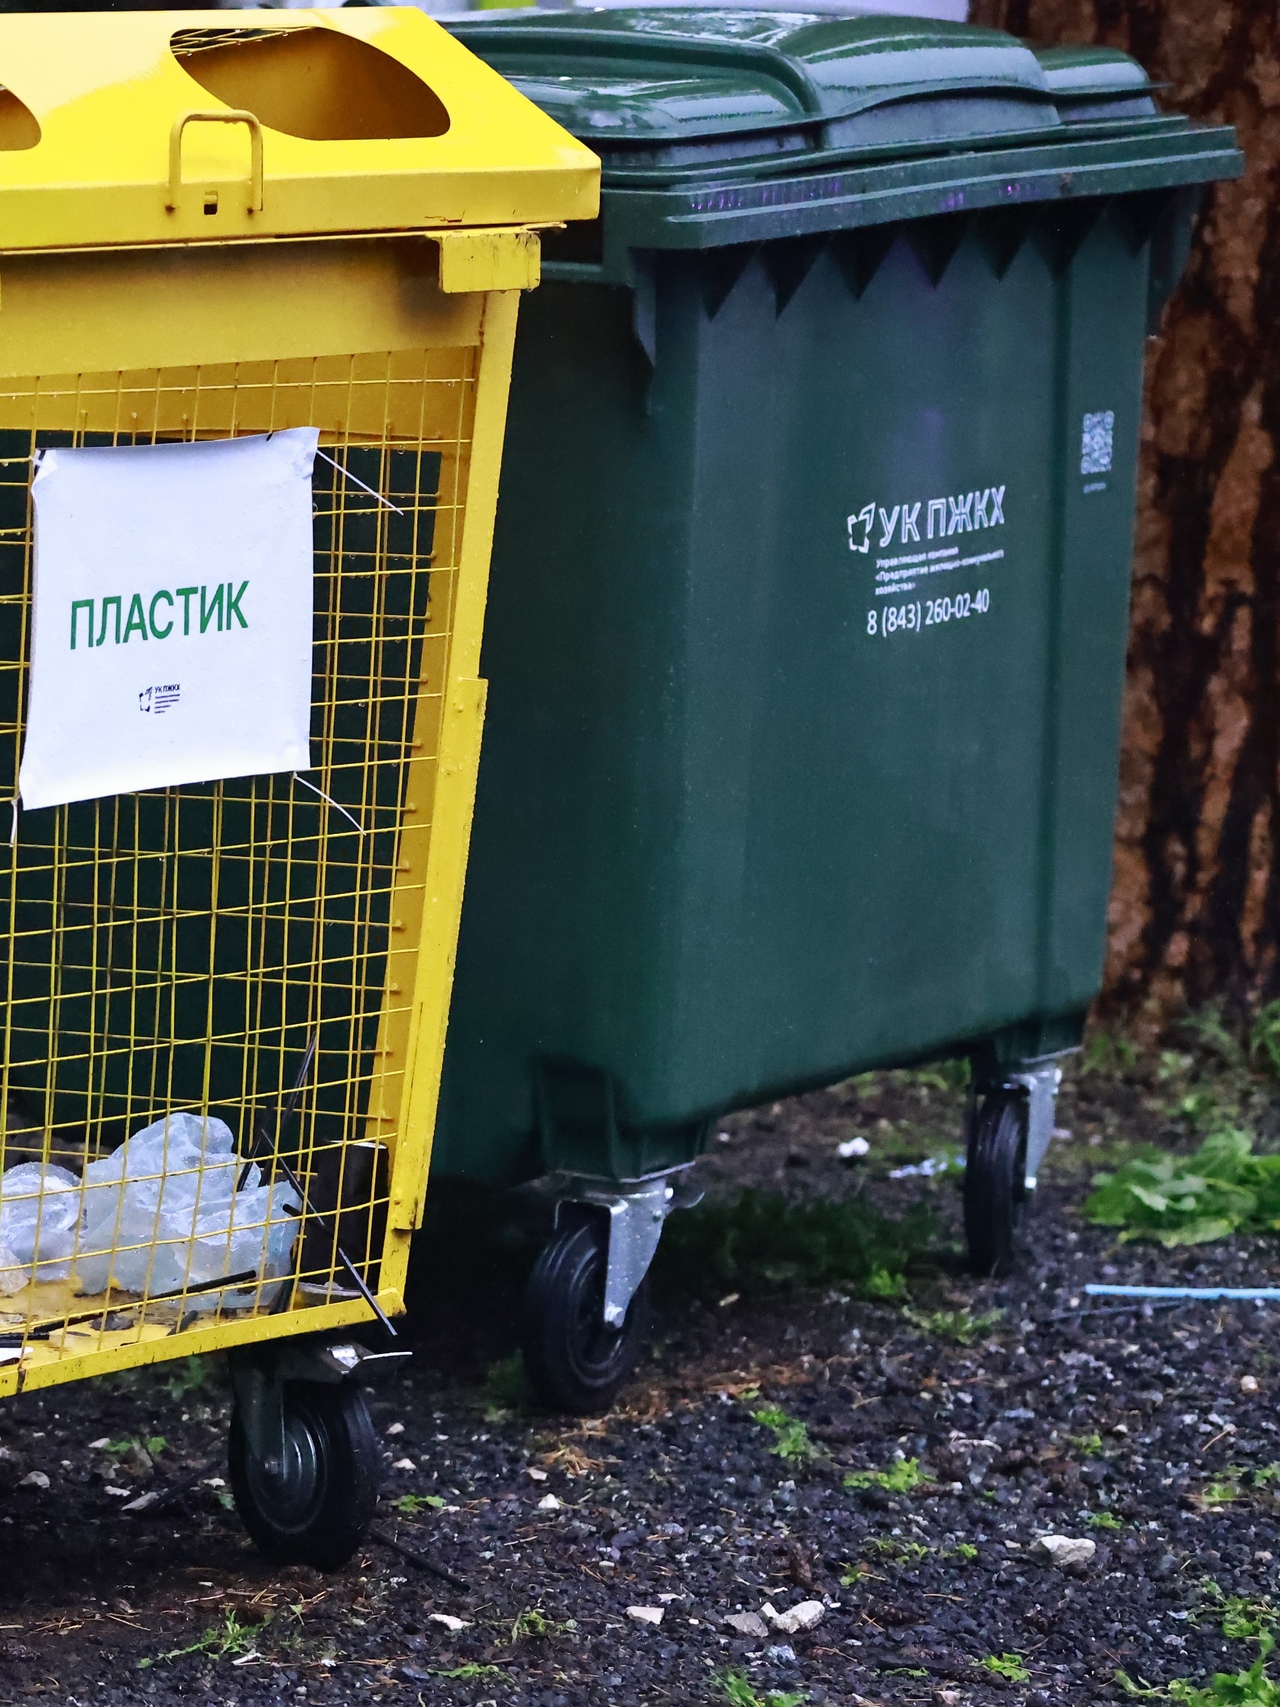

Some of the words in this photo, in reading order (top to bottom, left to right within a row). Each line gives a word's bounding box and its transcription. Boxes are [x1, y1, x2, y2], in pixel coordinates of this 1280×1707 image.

[879, 502, 922, 548] УК
[927, 485, 1006, 539] ПЖКХ
[70, 580, 250, 650] ПЛАСТИК
[867, 610, 877, 635] 8
[882, 601, 921, 637] (843)
[925, 588, 990, 625] 260-02-40
